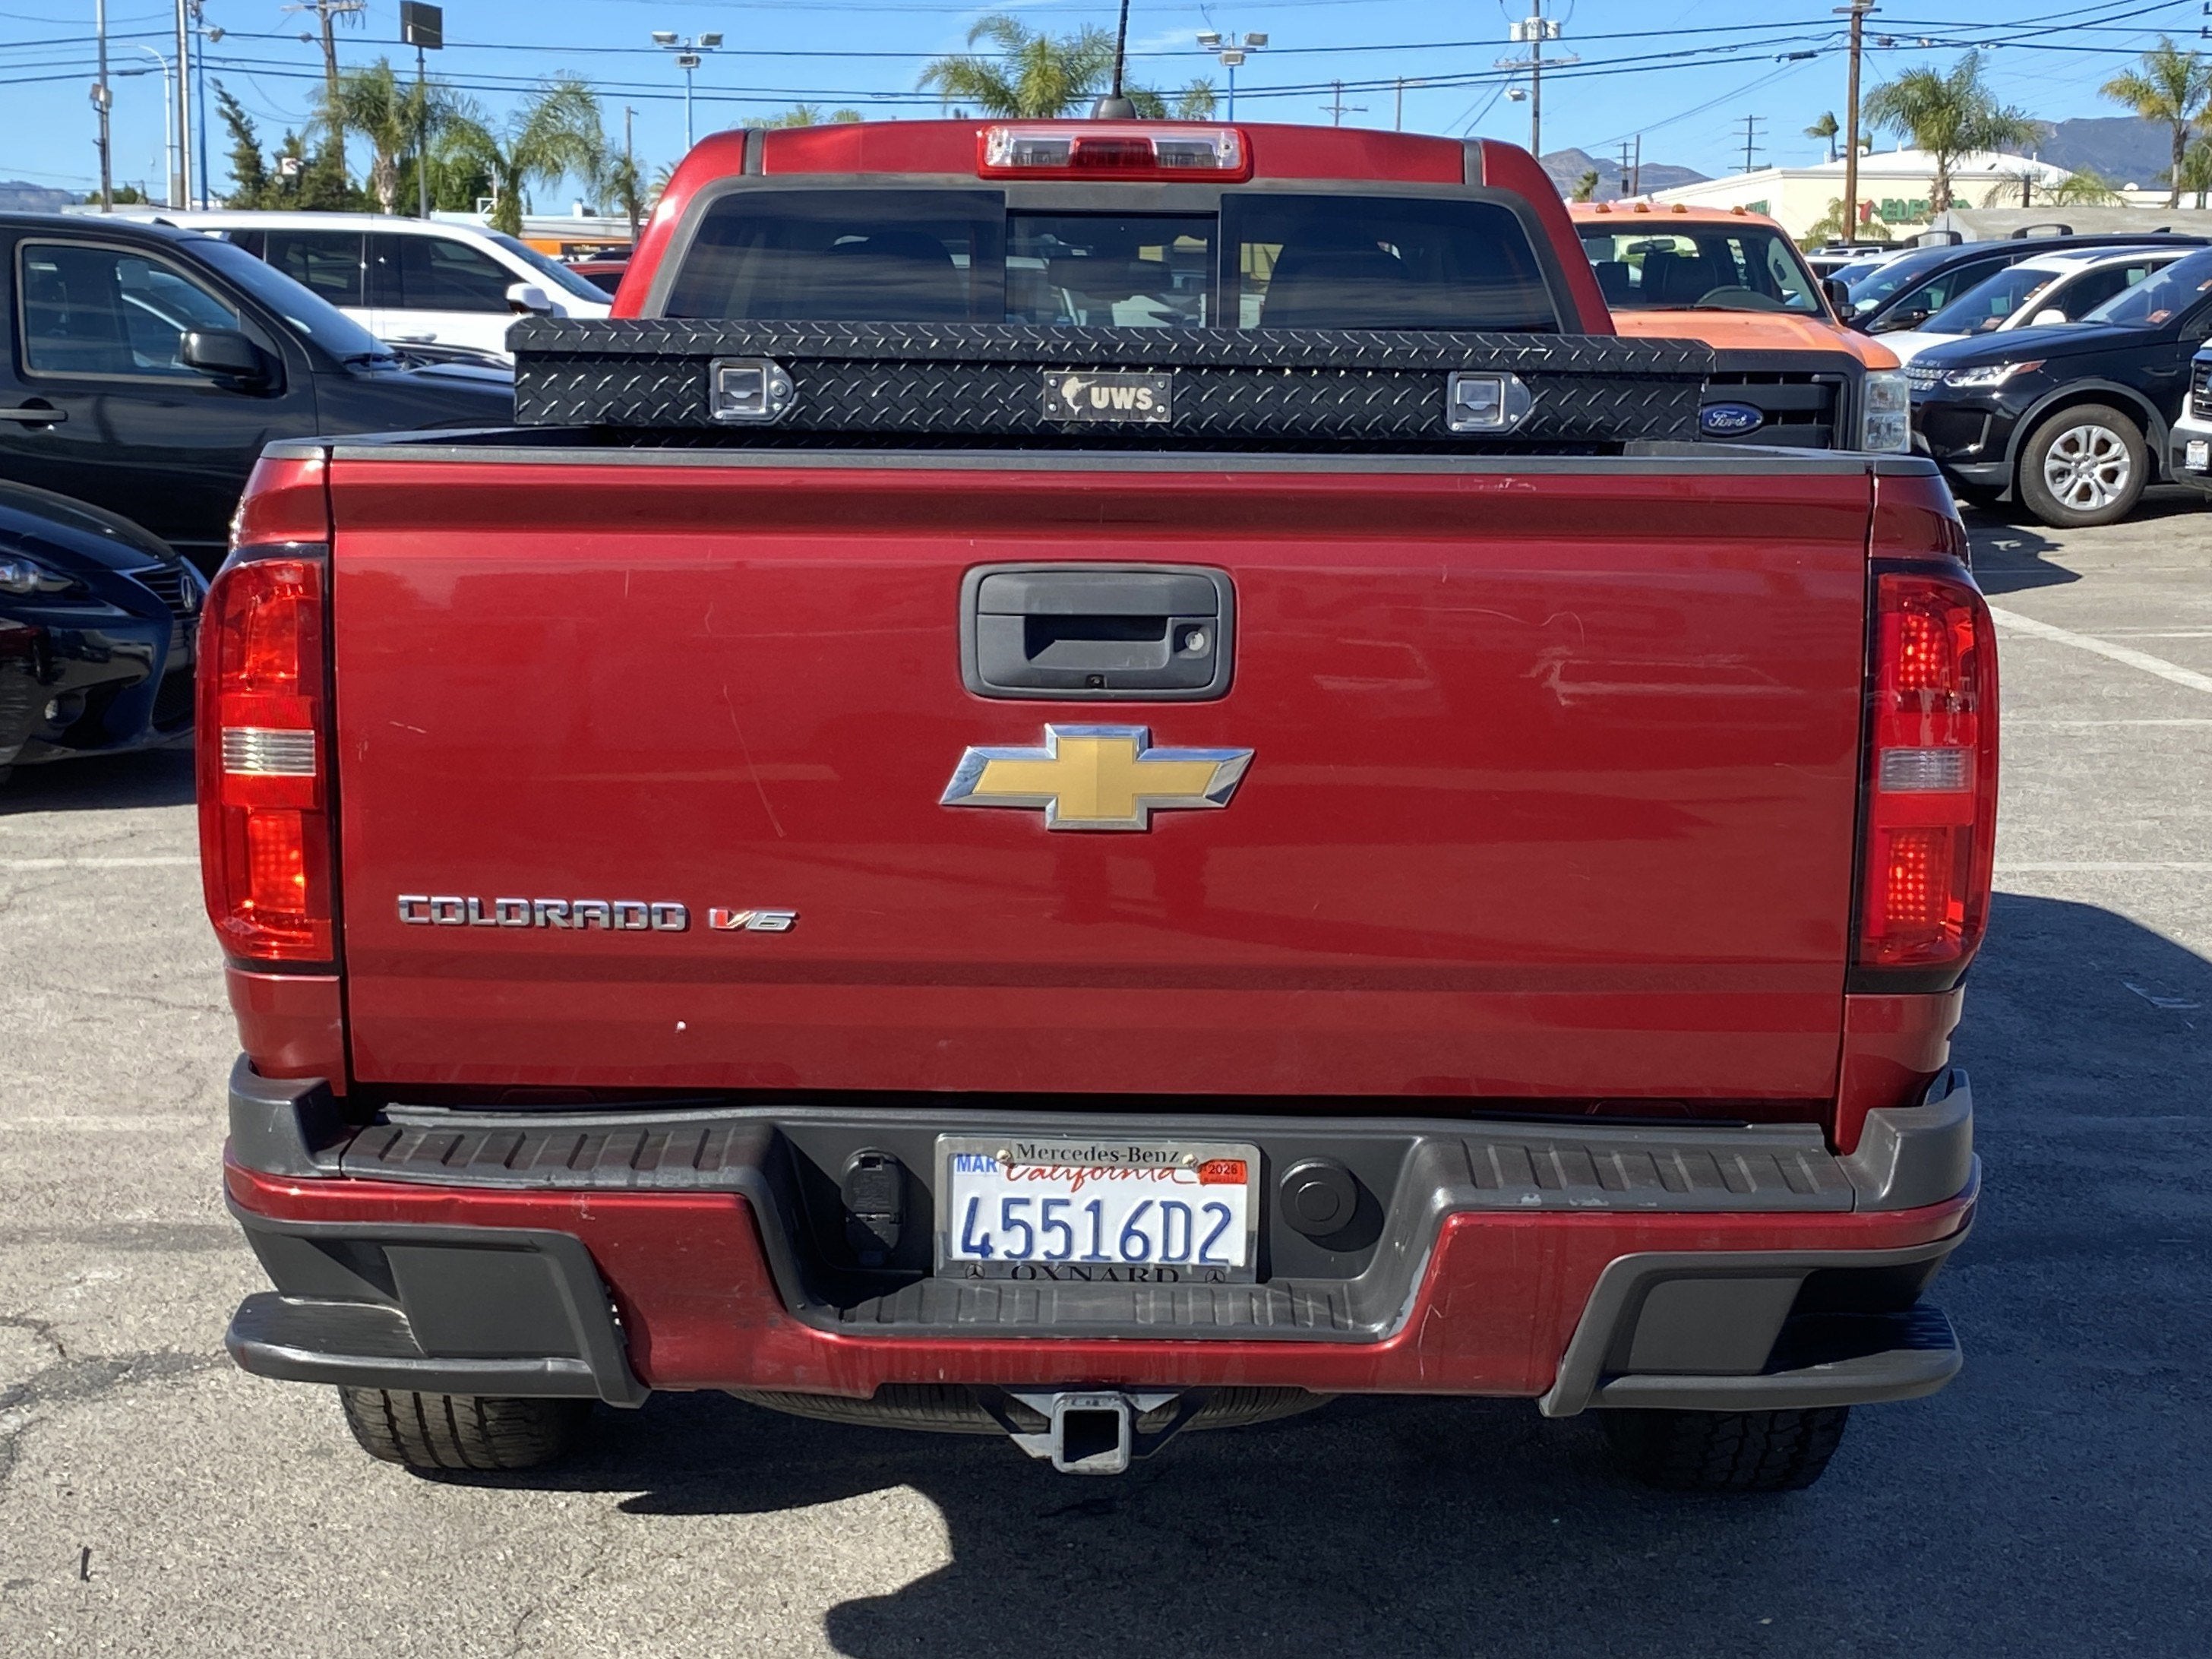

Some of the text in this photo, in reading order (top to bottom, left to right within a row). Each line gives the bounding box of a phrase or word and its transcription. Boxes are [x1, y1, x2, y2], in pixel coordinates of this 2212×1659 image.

[1090, 387, 1153, 410] UWS
[1708, 410, 1747, 427] Ford
[397, 894, 798, 931] COLORADO V6
[956, 1154, 998, 1173] MAR
[1016, 1143, 1180, 1164] Mercedes-Benz
[1006, 1162, 1197, 1193] California
[961, 1196, 1231, 1263] 45516D2
[1011, 1265, 1179, 1282] OXNARD
